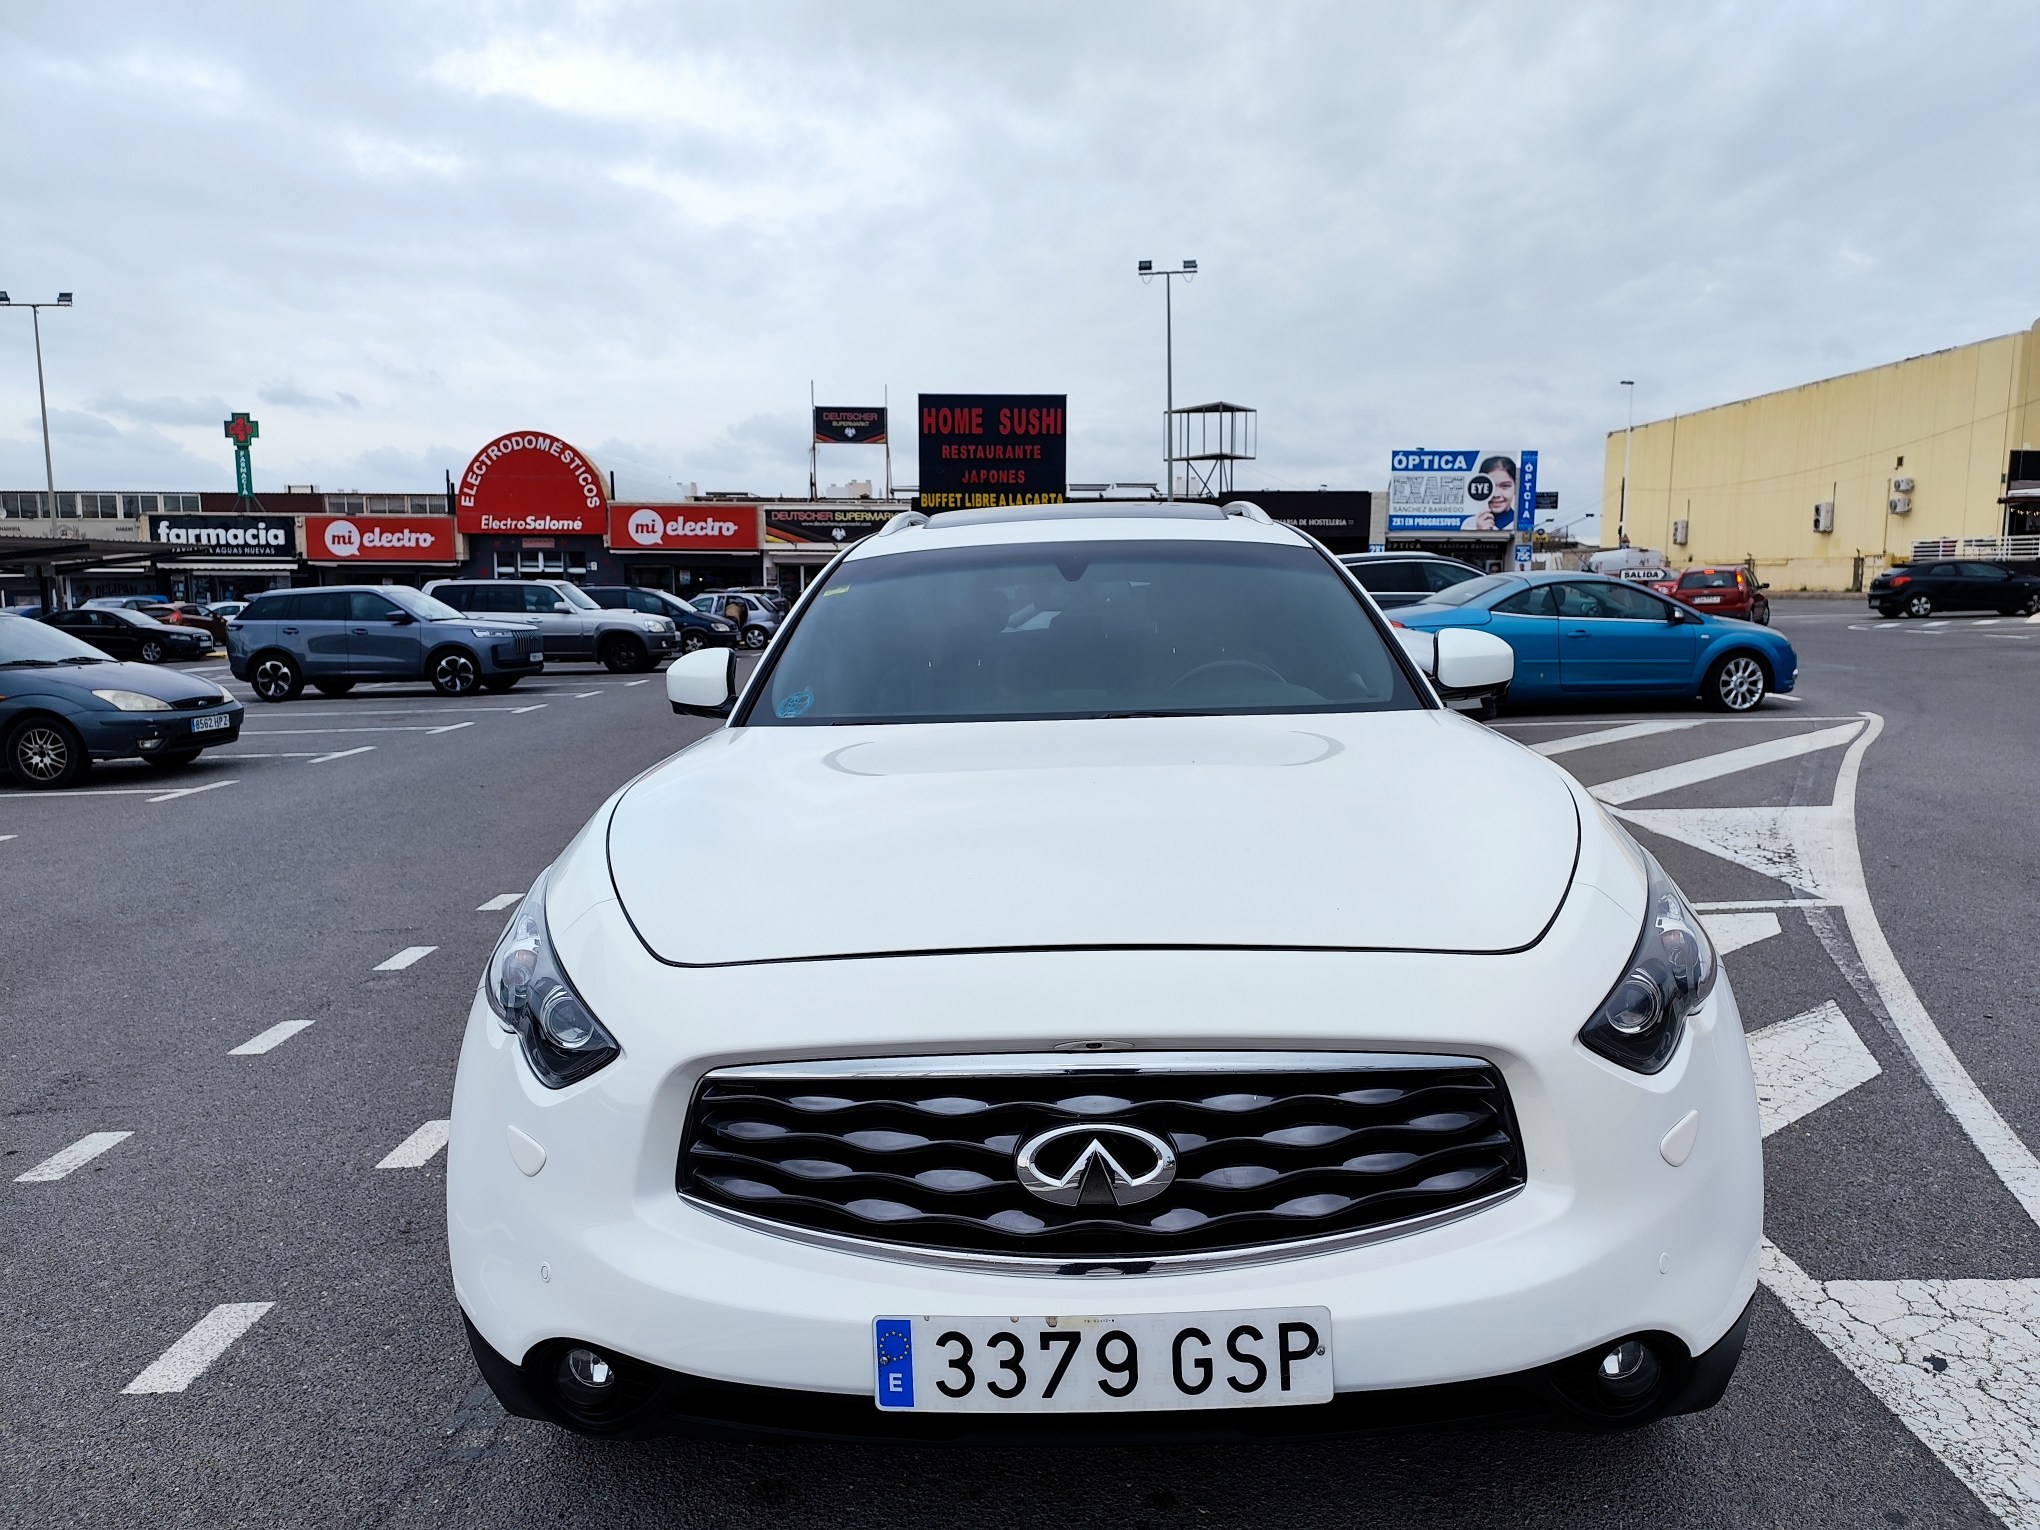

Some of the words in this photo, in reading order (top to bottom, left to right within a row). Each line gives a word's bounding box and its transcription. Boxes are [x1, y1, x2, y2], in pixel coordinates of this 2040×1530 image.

[823, 412, 877, 420] DEUTSCHER
[922, 407, 983, 434] HOME
[999, 408, 1062, 435] SUSHI
[941, 445, 1041, 459] RESTAURANTE
[1393, 452, 1467, 470] ÓPTICA
[240, 450, 248, 495] FARMACIA
[461, 435, 600, 508] ELECTRODOMÉSTICOS
[961, 470, 1026, 484] JAPONES
[1470, 483, 1489, 495] EYE
[920, 493, 962, 507] BUFFET
[965, 493, 997, 507] LIBRE
[998, 493, 1005, 507] A
[1009, 493, 1023, 506] LA
[1025, 493, 1064, 505] CARTA
[481, 514, 583, 530] ElectroSalomé
[771, 511, 833, 521] DEUTSCHER
[158, 521, 286, 545] farmacia
[635, 519, 657, 534] mi
[666, 516, 738, 536] electro
[332, 530, 354, 545] mi
[363, 527, 435, 547] electro
[215, 547, 242, 555] AGUAS
[244, 547, 275, 555] NUEVAS
[1624, 570, 1659, 579] SALIDA
[195, 718, 213, 730] 8562
[889, 1372, 903, 1393] E
[935, 1330, 1139, 1399] 3379
[1171, 1322, 1320, 1396] GSP
